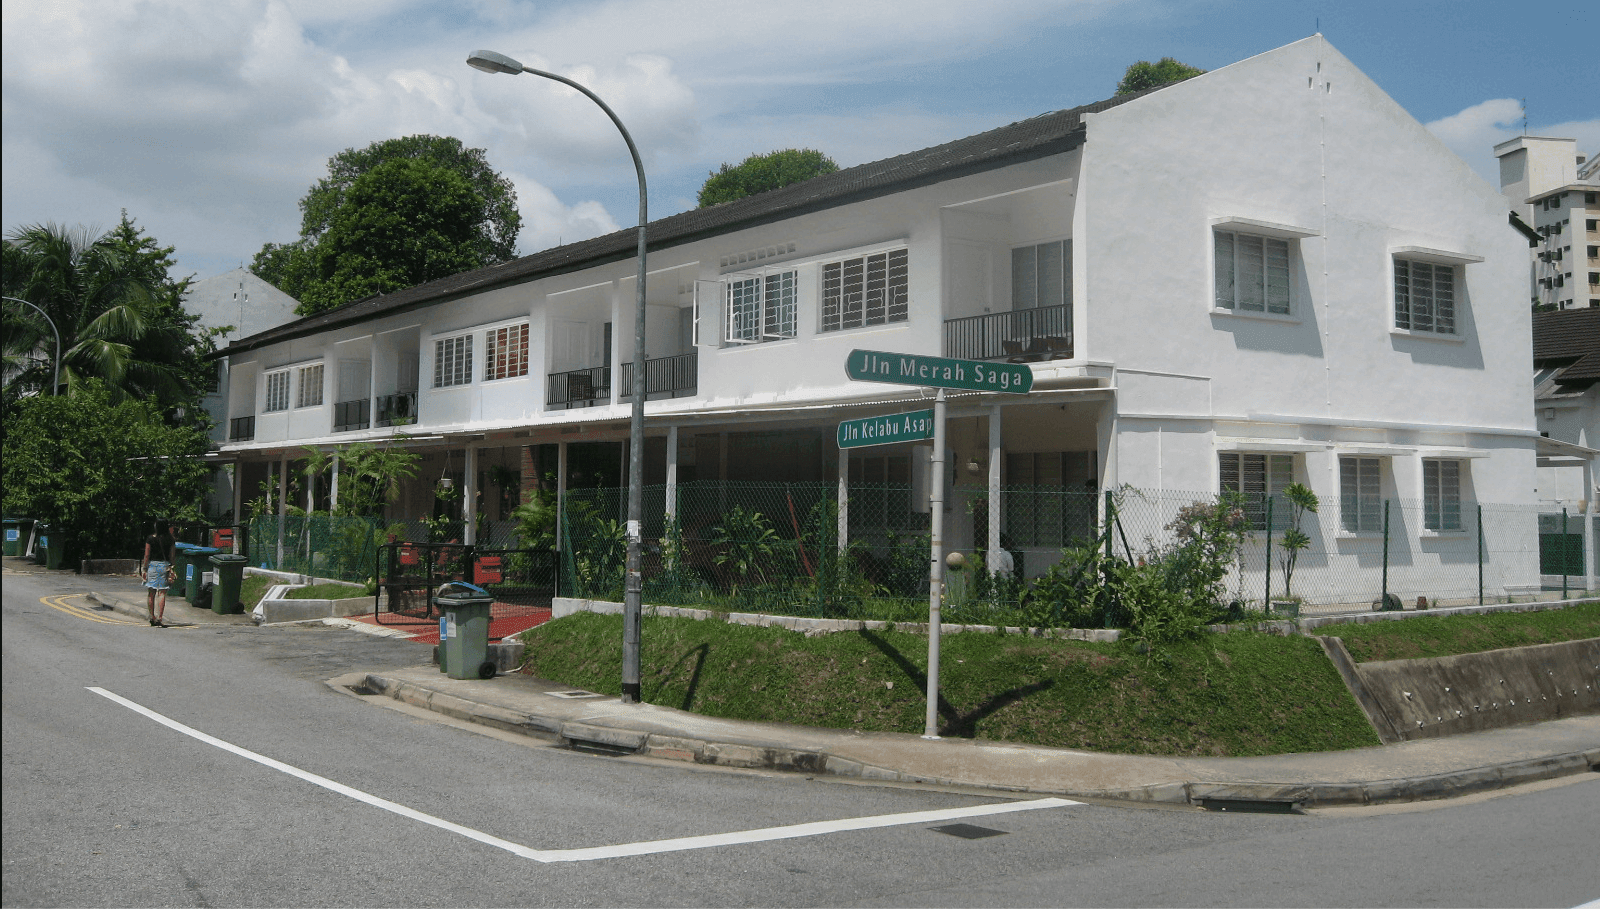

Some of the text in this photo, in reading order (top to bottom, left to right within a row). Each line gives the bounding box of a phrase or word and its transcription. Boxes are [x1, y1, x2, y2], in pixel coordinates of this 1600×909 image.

[860, 355, 1021, 389] Jln Merah Saga
[843, 416, 932, 441] Jln Kelabu Asap
